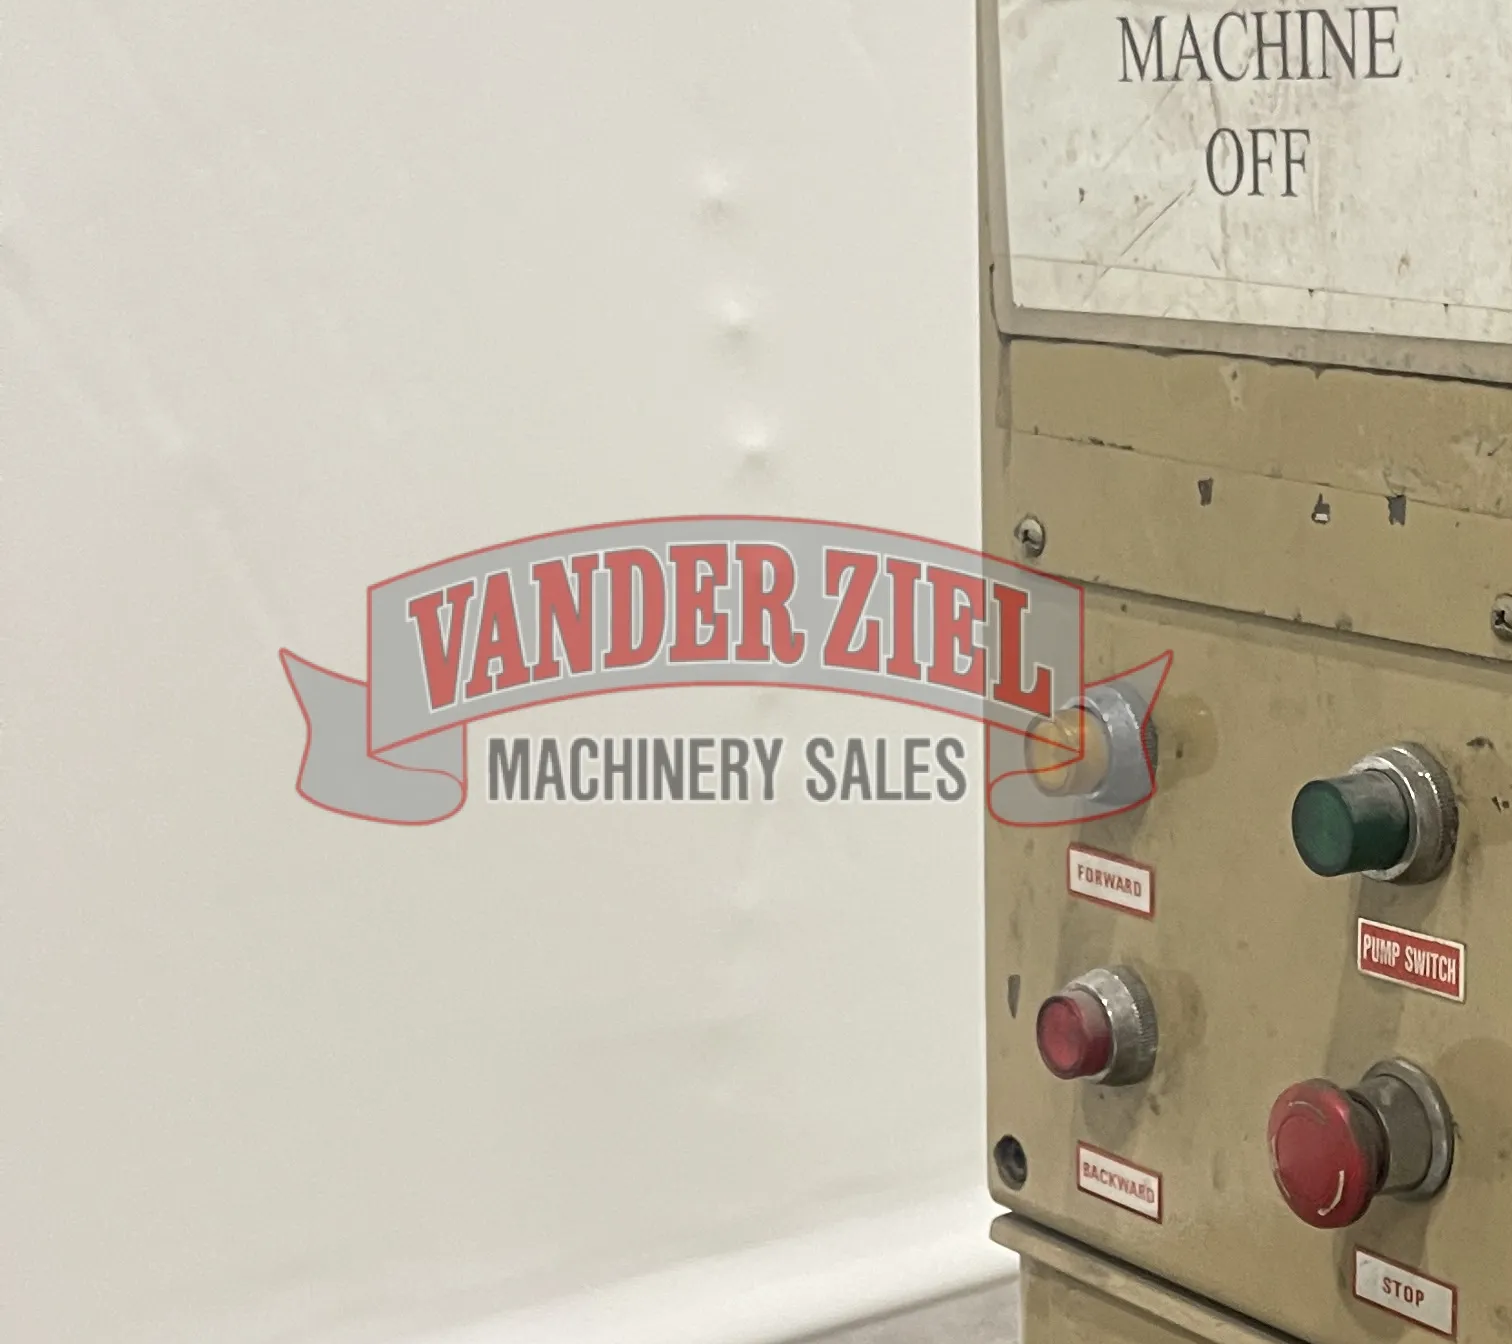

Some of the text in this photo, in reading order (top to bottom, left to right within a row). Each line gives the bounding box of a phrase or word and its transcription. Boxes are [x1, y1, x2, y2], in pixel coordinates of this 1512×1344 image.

[1116, 6, 1404, 83] MACHINE
[1205, 127, 1312, 198] OFF
[1077, 863, 1142, 898] FORWARD
[1362, 933, 1457, 985] PUMP SWITCH
[1082, 1161, 1155, 1204] BACKWARD
[1382, 1276, 1424, 1308] STOP
